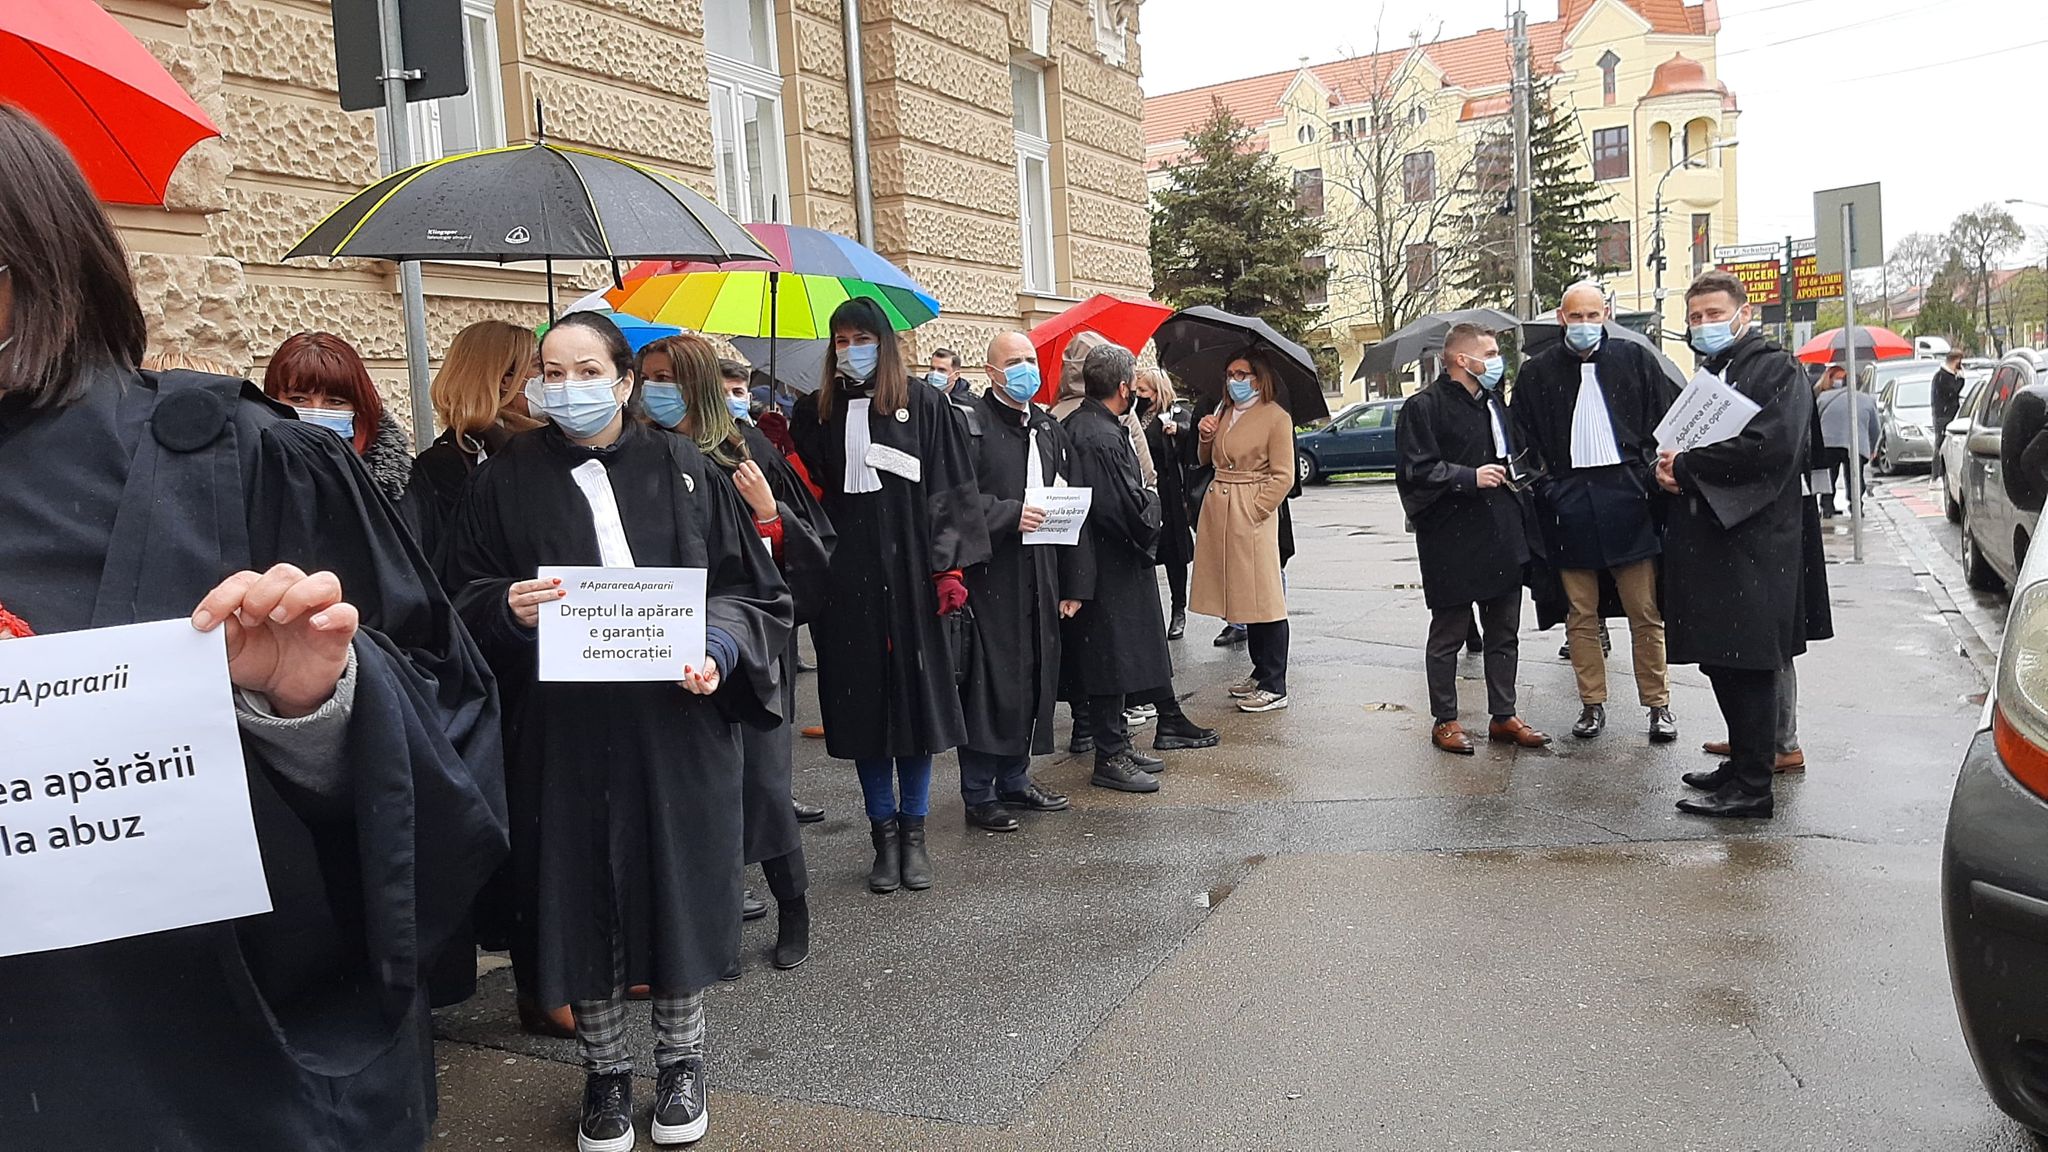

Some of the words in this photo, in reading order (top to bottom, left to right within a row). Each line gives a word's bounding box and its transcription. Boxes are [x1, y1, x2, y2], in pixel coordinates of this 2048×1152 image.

[1742, 245, 1776, 254] Schubert
[1749, 281, 1774, 292] LIMBI
[1809, 276, 1818, 286] de
[1820, 274, 1842, 285] LIMBI
[1796, 286, 1835, 300] APOSTILE
[1703, 400, 1713, 412] nu
[1700, 424, 1710, 435] de
[1708, 400, 1731, 425] opinie
[580, 580, 674, 592] #AparareaApararii
[560, 604, 617, 620] Dreptul
[621, 604, 633, 617] la
[638, 604, 694, 620] apărare
[590, 627, 598, 638] e
[602, 625, 664, 642] garanția
[582, 646, 672, 662] democrației
[0, 664, 130, 707] aApararii
[43, 745, 196, 804] apărării
[0, 825, 37, 857] la
[48, 813, 145, 850] abuz
